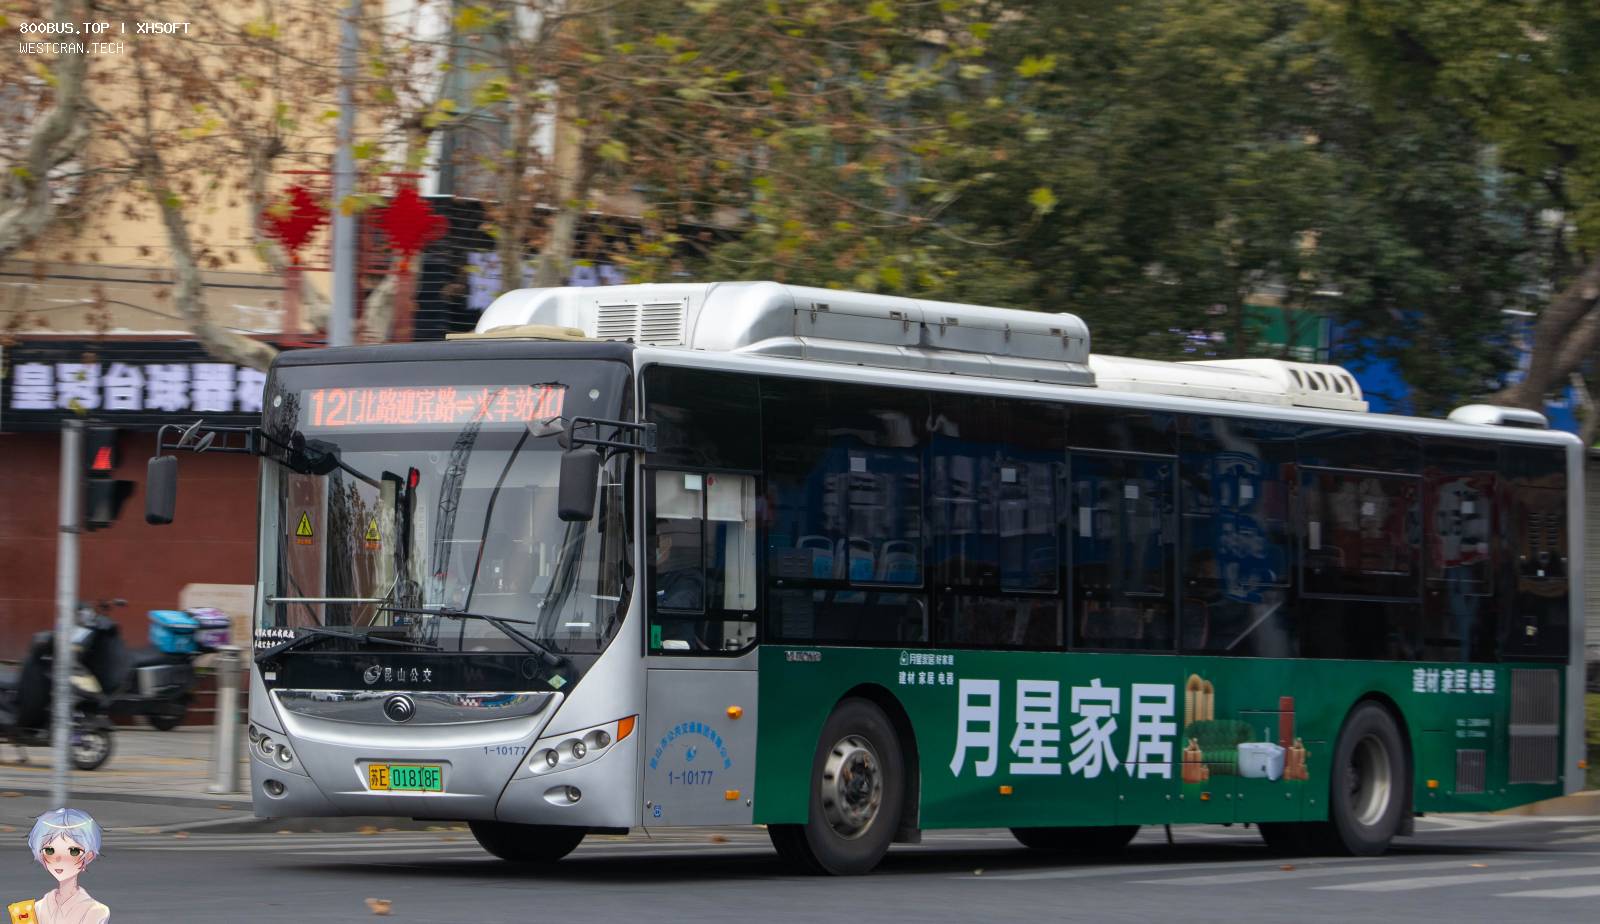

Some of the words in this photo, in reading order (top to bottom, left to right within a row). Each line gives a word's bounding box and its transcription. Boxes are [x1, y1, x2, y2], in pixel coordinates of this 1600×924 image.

[310, 388, 345, 426] 12
[384, 667, 433, 683] 昆山公交
[918, 671, 935, 685] 家居
[938, 672, 954, 685] 电器
[1441, 668, 1467, 694] 家居
[949, 678, 1177, 779] 月星家居
[484, 746, 526, 756] 1-10177
[668, 770, 713, 785] 1-10177
